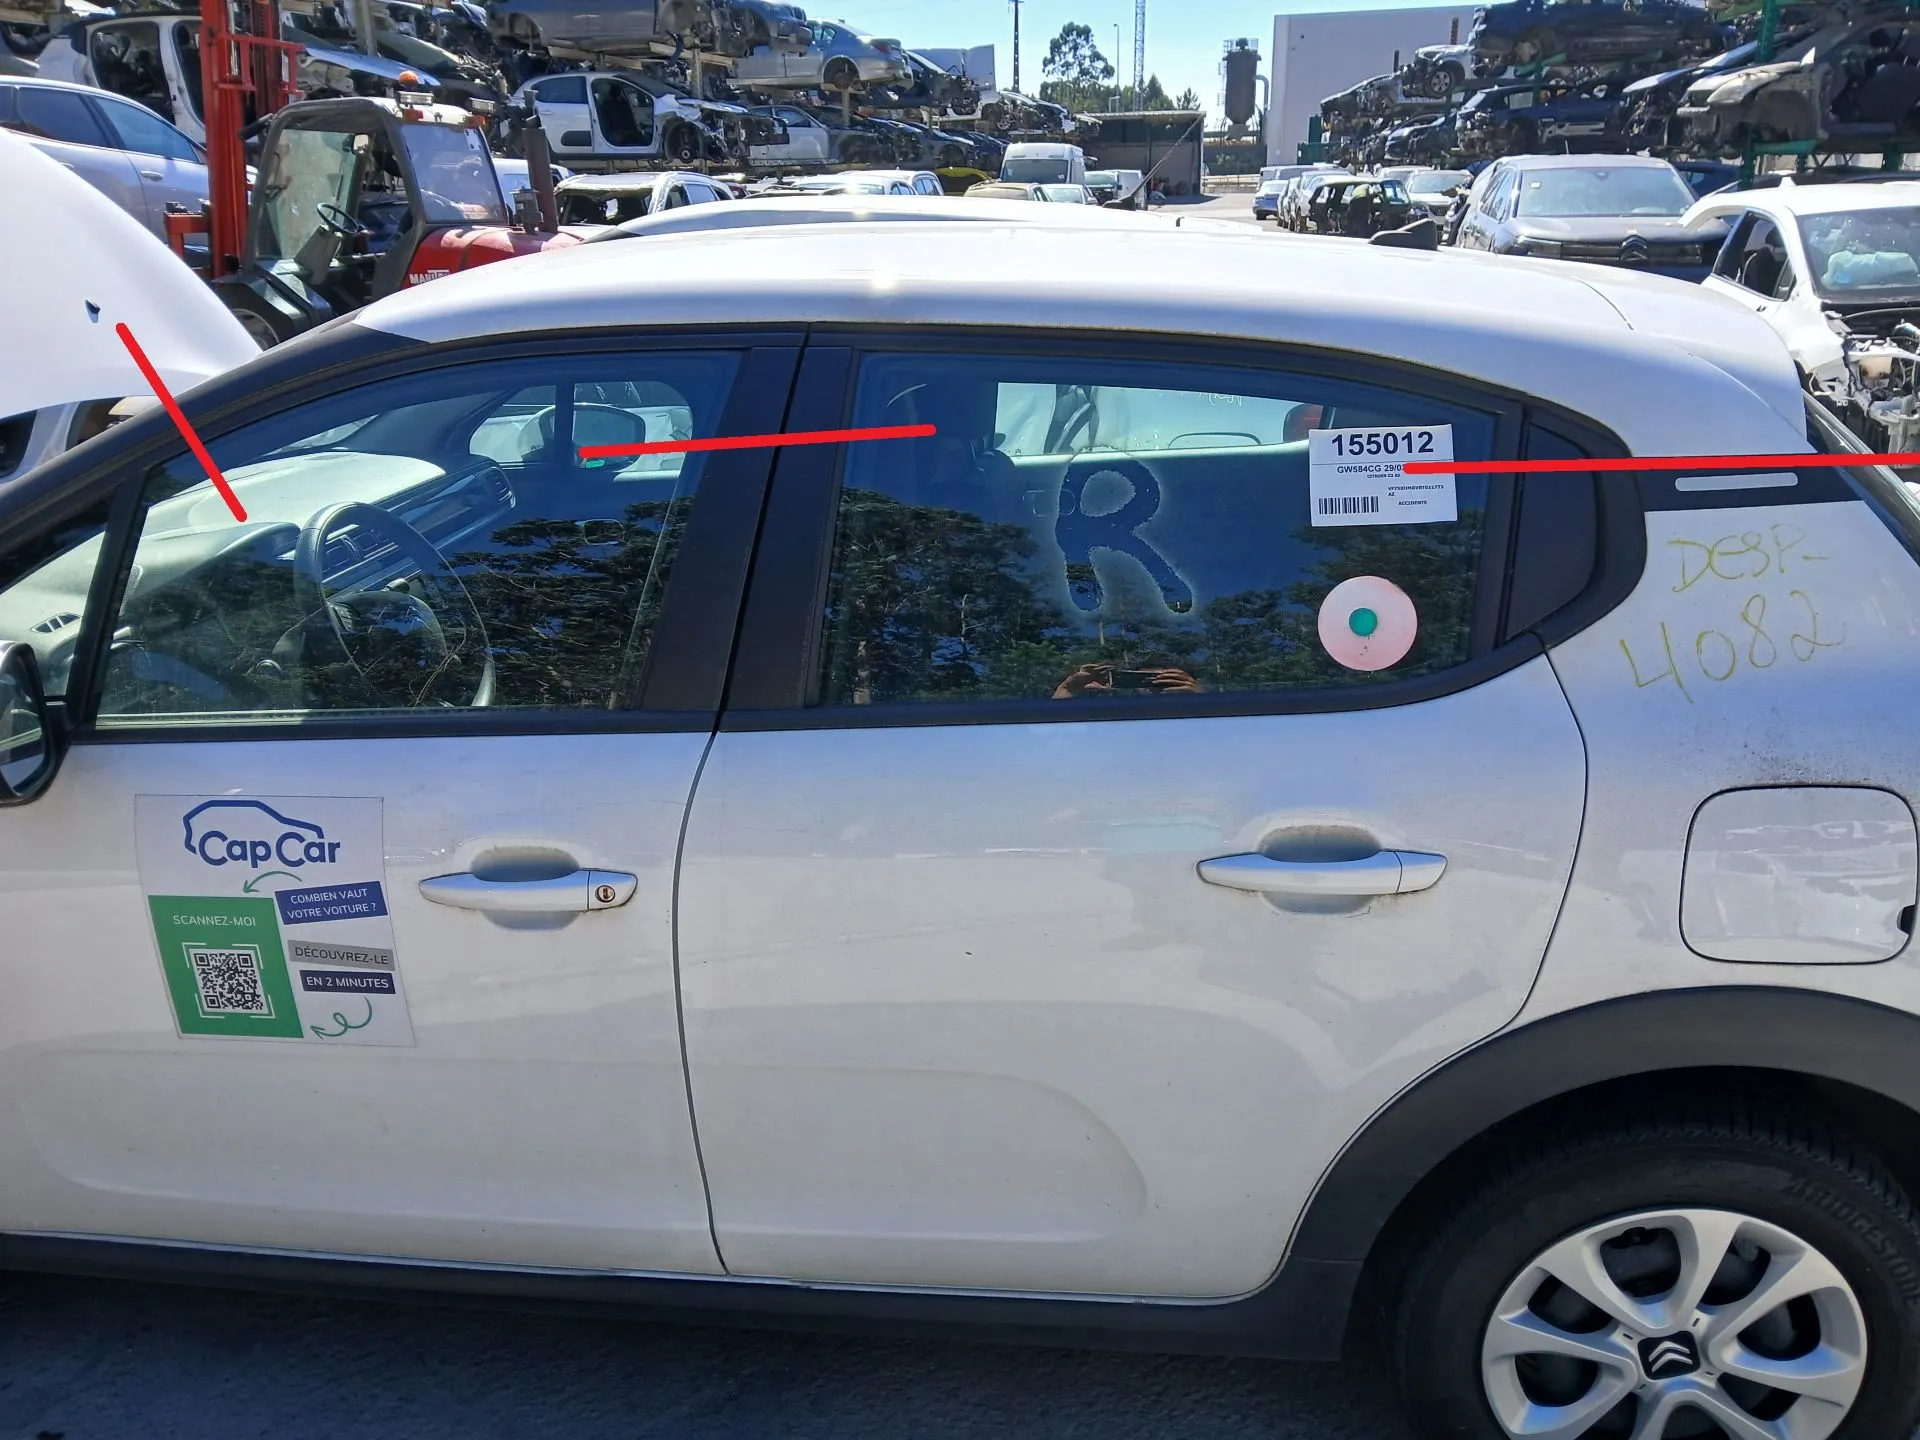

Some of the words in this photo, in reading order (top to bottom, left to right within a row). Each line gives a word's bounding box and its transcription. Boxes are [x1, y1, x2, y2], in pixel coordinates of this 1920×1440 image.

[409, 269, 450, 284] MANIT
[1331, 431, 1434, 456] 155012
[1337, 464, 1381, 474] GW584CG
[1383, 463, 1403, 472] 29/0
[1055, 446, 1193, 614] R
[1619, 590, 1846, 704] 4082
[290, 891, 337, 905] COMBIEN
[338, 888, 368, 900] VAUT
[287, 906, 322, 919] VOTRE
[323, 904, 369, 917] VOITURE
[370, 903, 376, 912] ?
[173, 915, 256, 927] SCANNEZ-MOI
[295, 945, 388, 965] DÉCOUVREZ-LE
[306, 977, 322, 987] EN
[325, 977, 333, 987] 2
[335, 977, 389, 989] MINUTES
